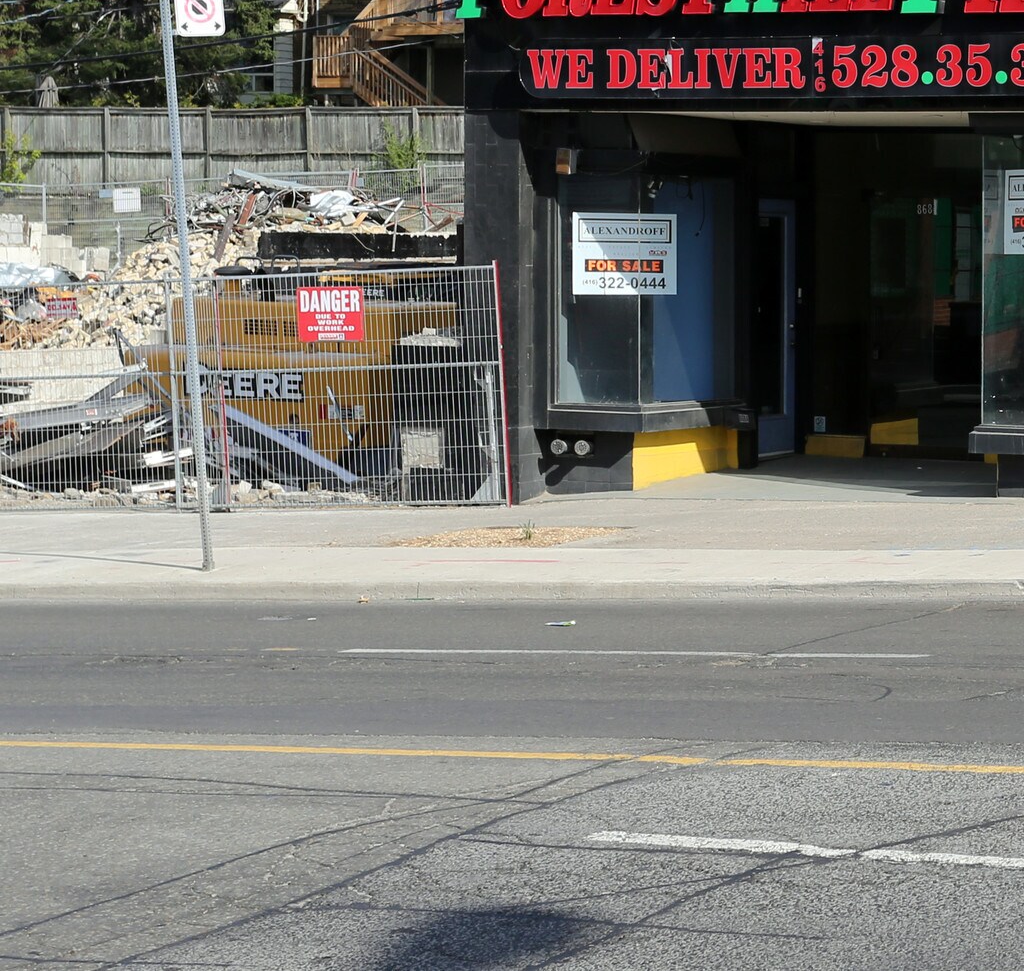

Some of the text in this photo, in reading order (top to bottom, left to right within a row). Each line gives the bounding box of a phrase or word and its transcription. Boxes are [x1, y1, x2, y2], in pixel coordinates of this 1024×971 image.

[526, 48, 593, 90] WE
[606, 47, 806, 90] DELIVER
[584, 226, 666, 236] ALEXANDROFF
[587, 260, 660, 272] FOR SALE
[598, 277, 667, 289] 322-0444
[300, 290, 360, 313] DANGER
